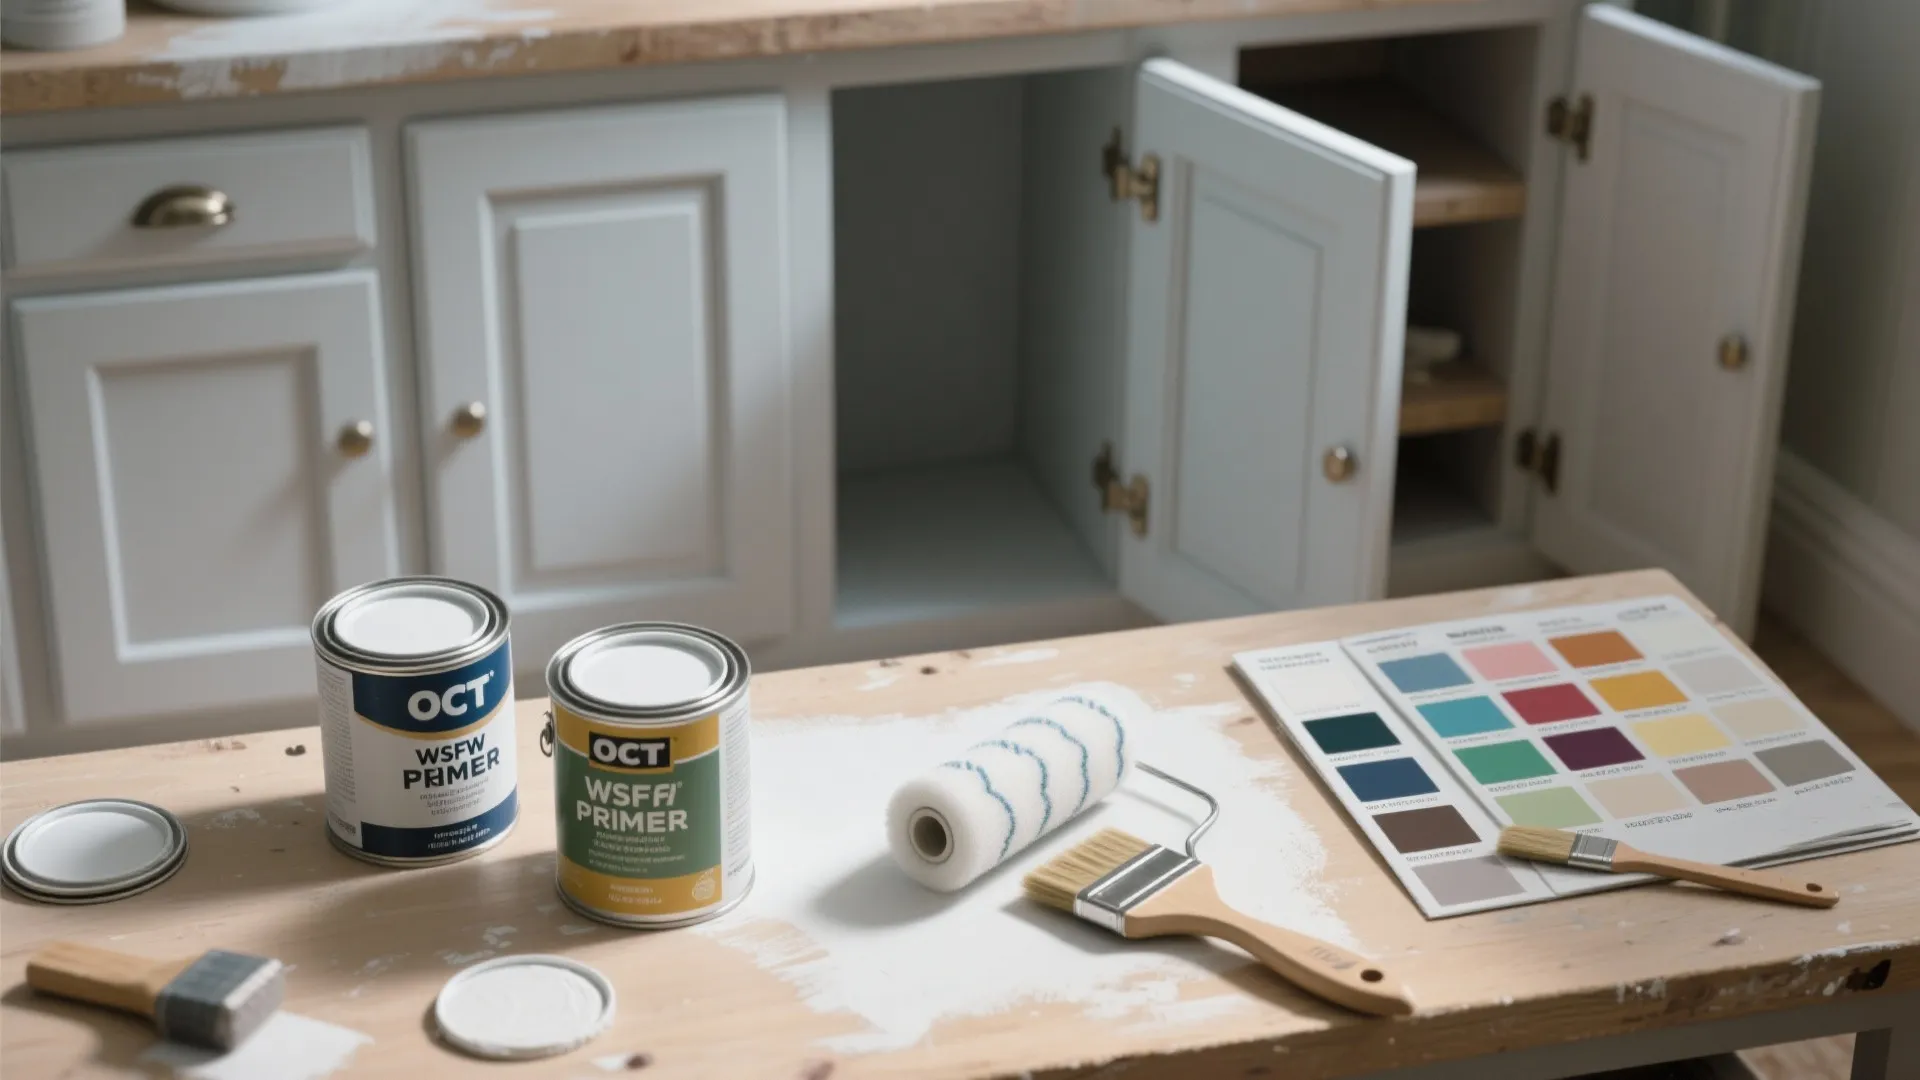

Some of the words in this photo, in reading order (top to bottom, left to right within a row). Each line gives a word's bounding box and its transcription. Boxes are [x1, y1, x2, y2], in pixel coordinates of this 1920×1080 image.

[407, 676, 490, 721] OCT
[415, 733, 486, 766] WSFW
[592, 738, 666, 766] OCT
[576, 799, 689, 833] PRIMER
